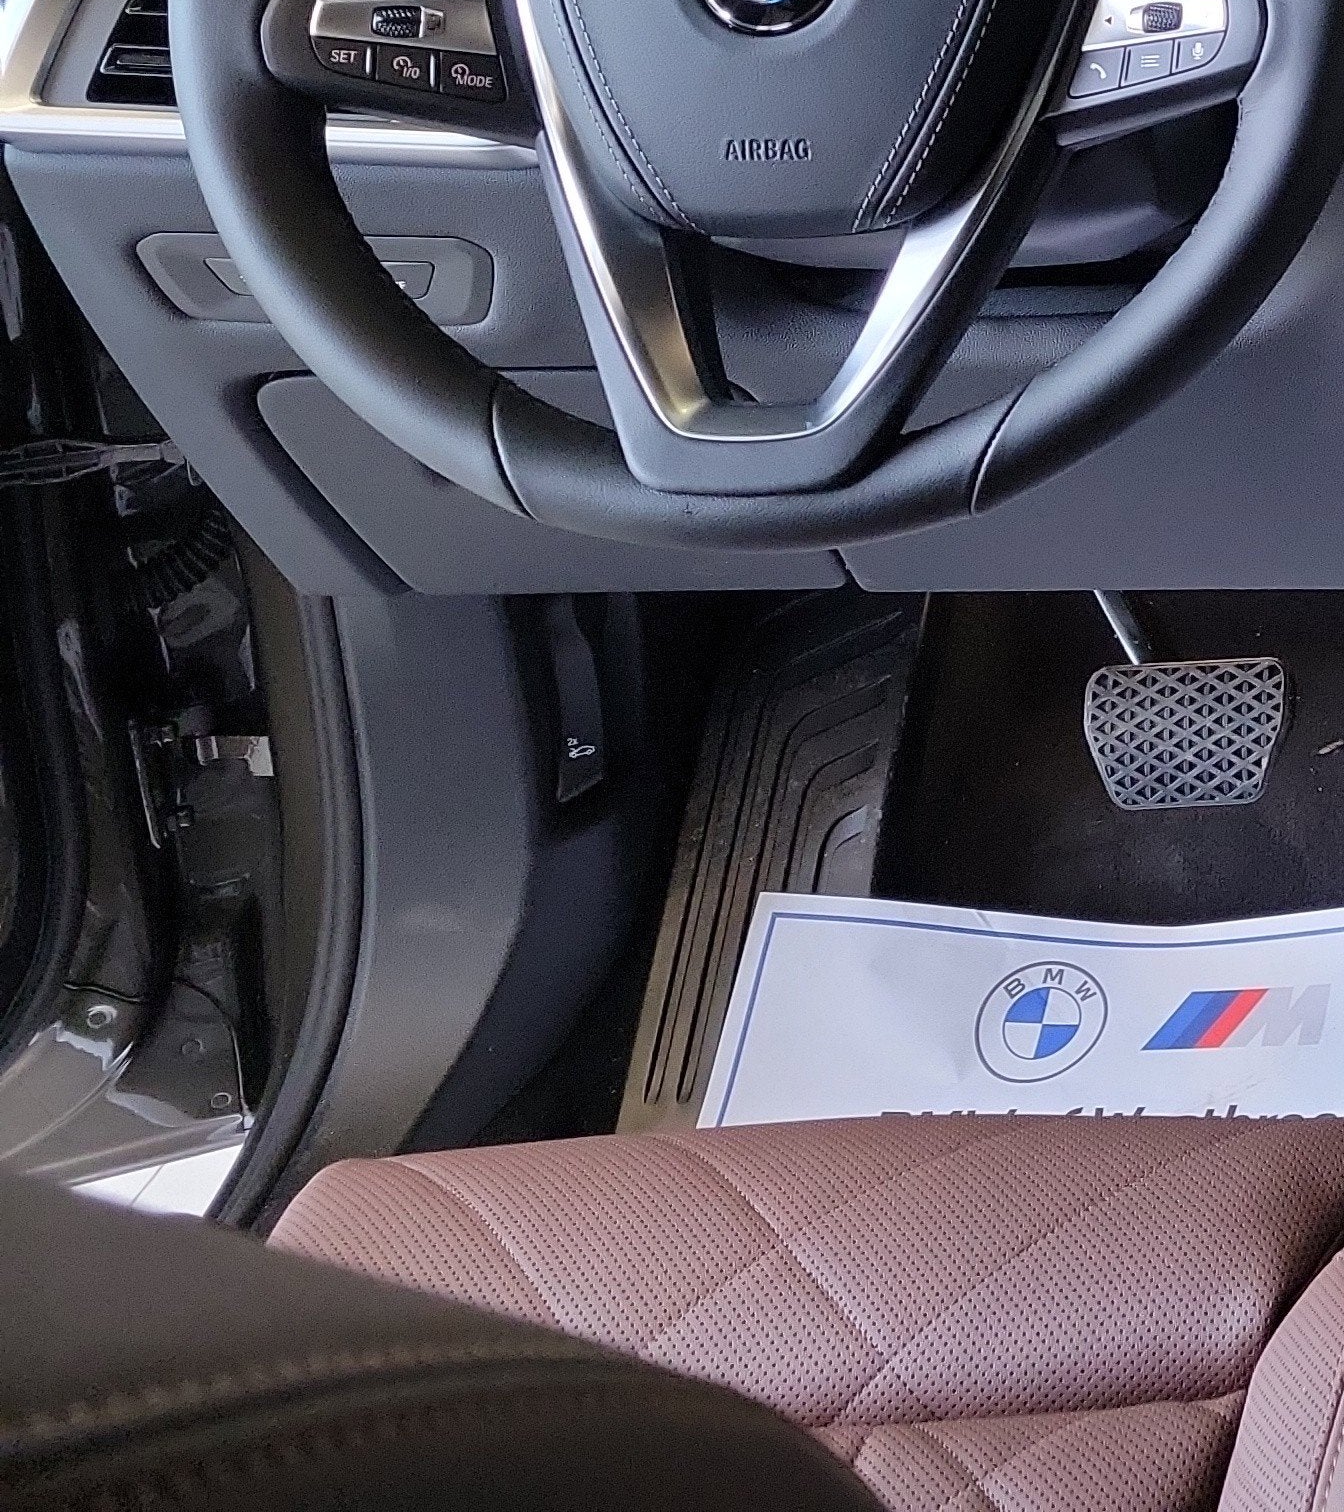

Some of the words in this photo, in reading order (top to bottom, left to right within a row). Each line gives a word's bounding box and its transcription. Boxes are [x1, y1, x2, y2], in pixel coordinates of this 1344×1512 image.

[330, 49, 358, 64] SET
[455, 74, 493, 89] MODE
[725, 138, 813, 162] AIRBAG
